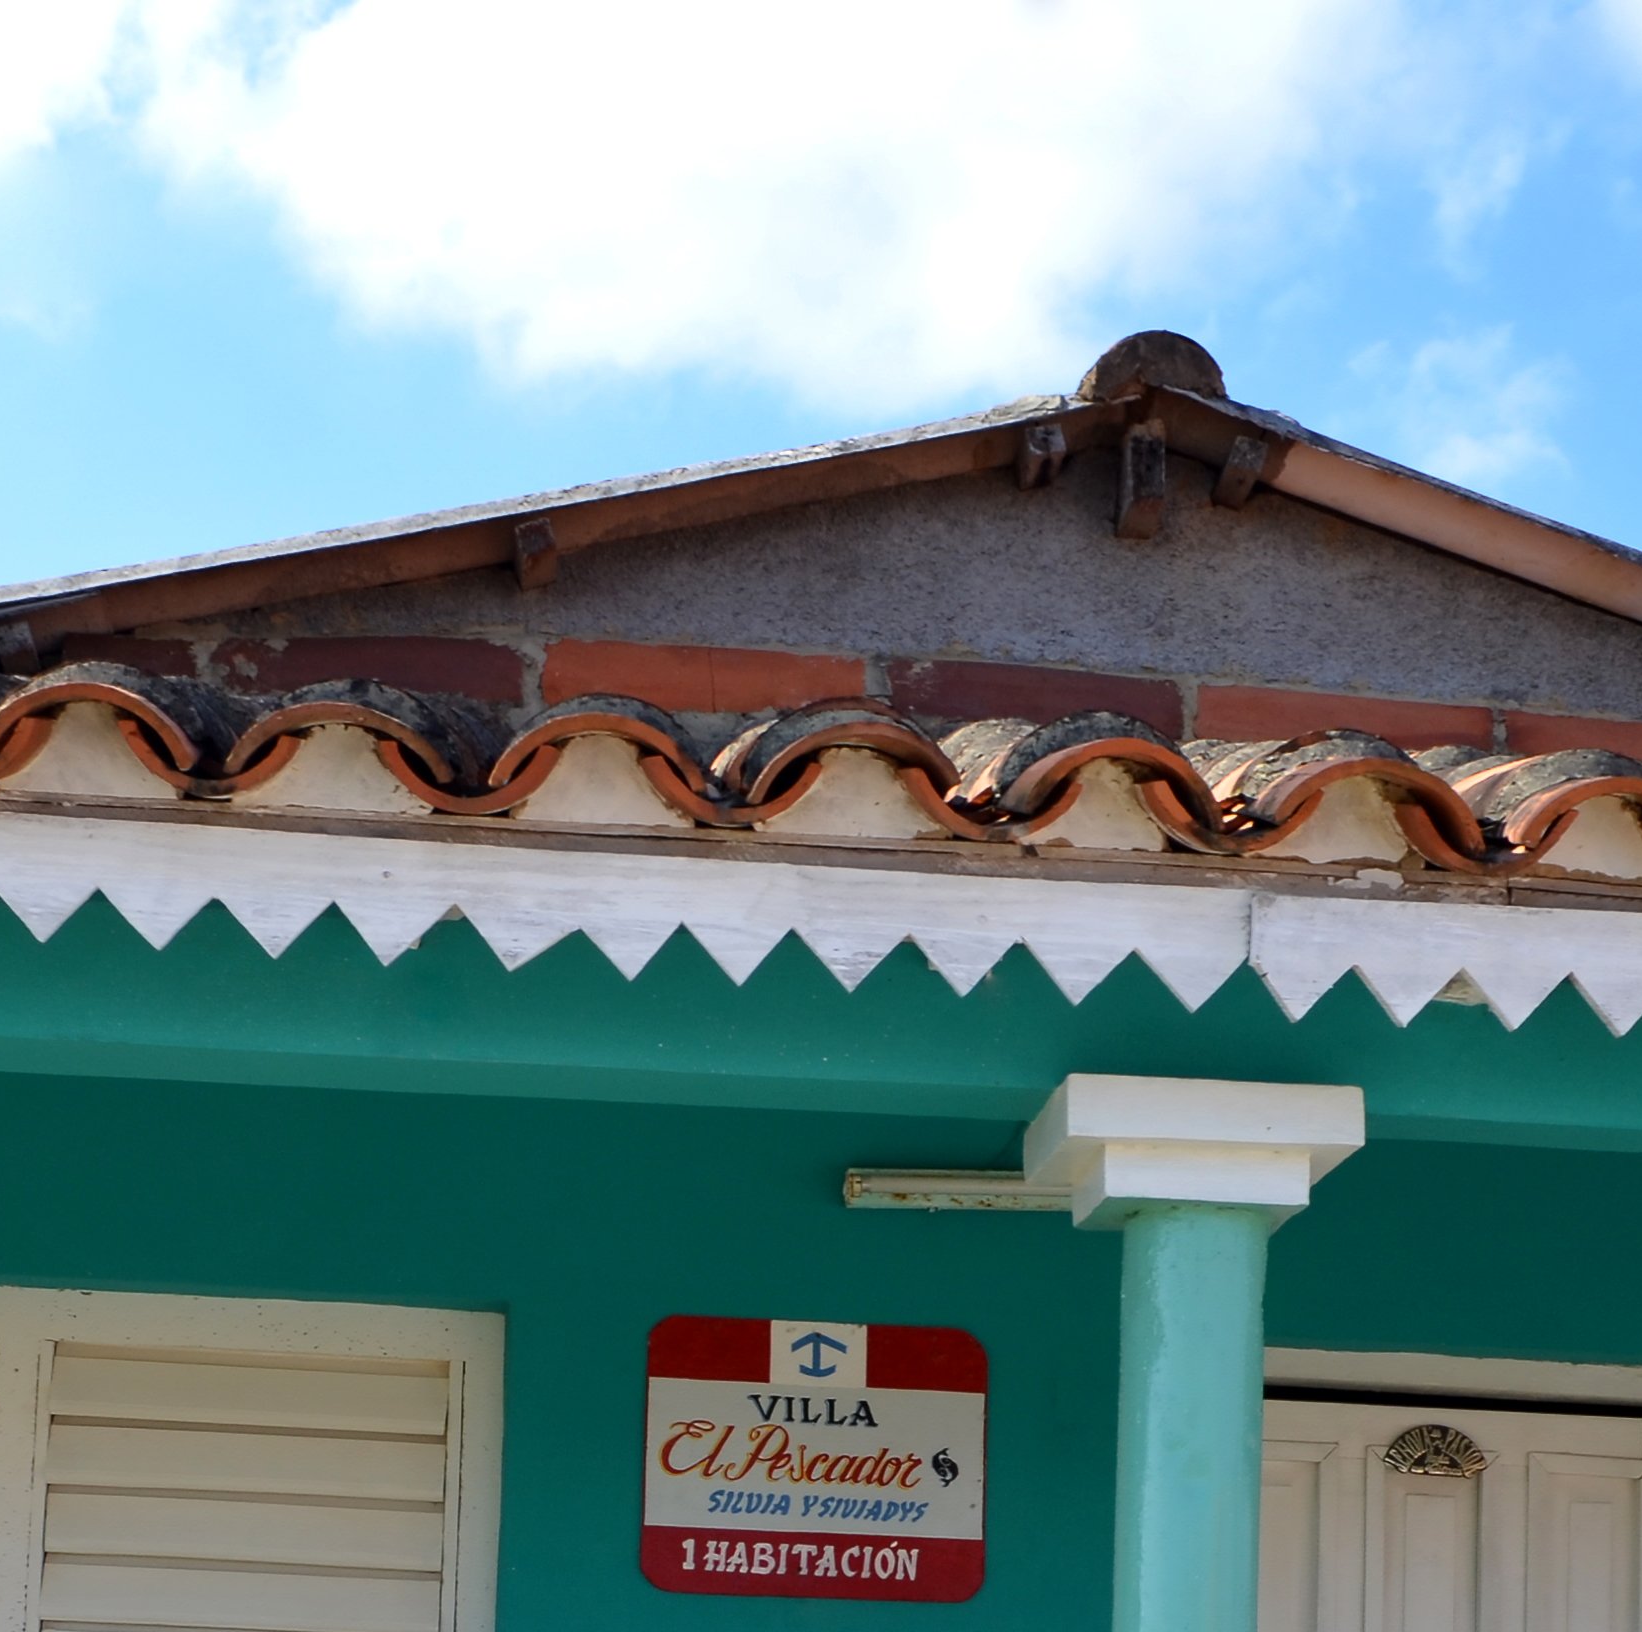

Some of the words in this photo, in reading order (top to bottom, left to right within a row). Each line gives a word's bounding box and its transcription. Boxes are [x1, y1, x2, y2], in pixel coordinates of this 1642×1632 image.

[747, 1394, 878, 1428] VILLA
[659, 1420, 735, 1480] El
[724, 1423, 923, 1489] Pescador
[707, 1489, 792, 1516] SILVIA
[681, 1538, 696, 1570] 1
[702, 1540, 920, 1581] HABITACIÓN
